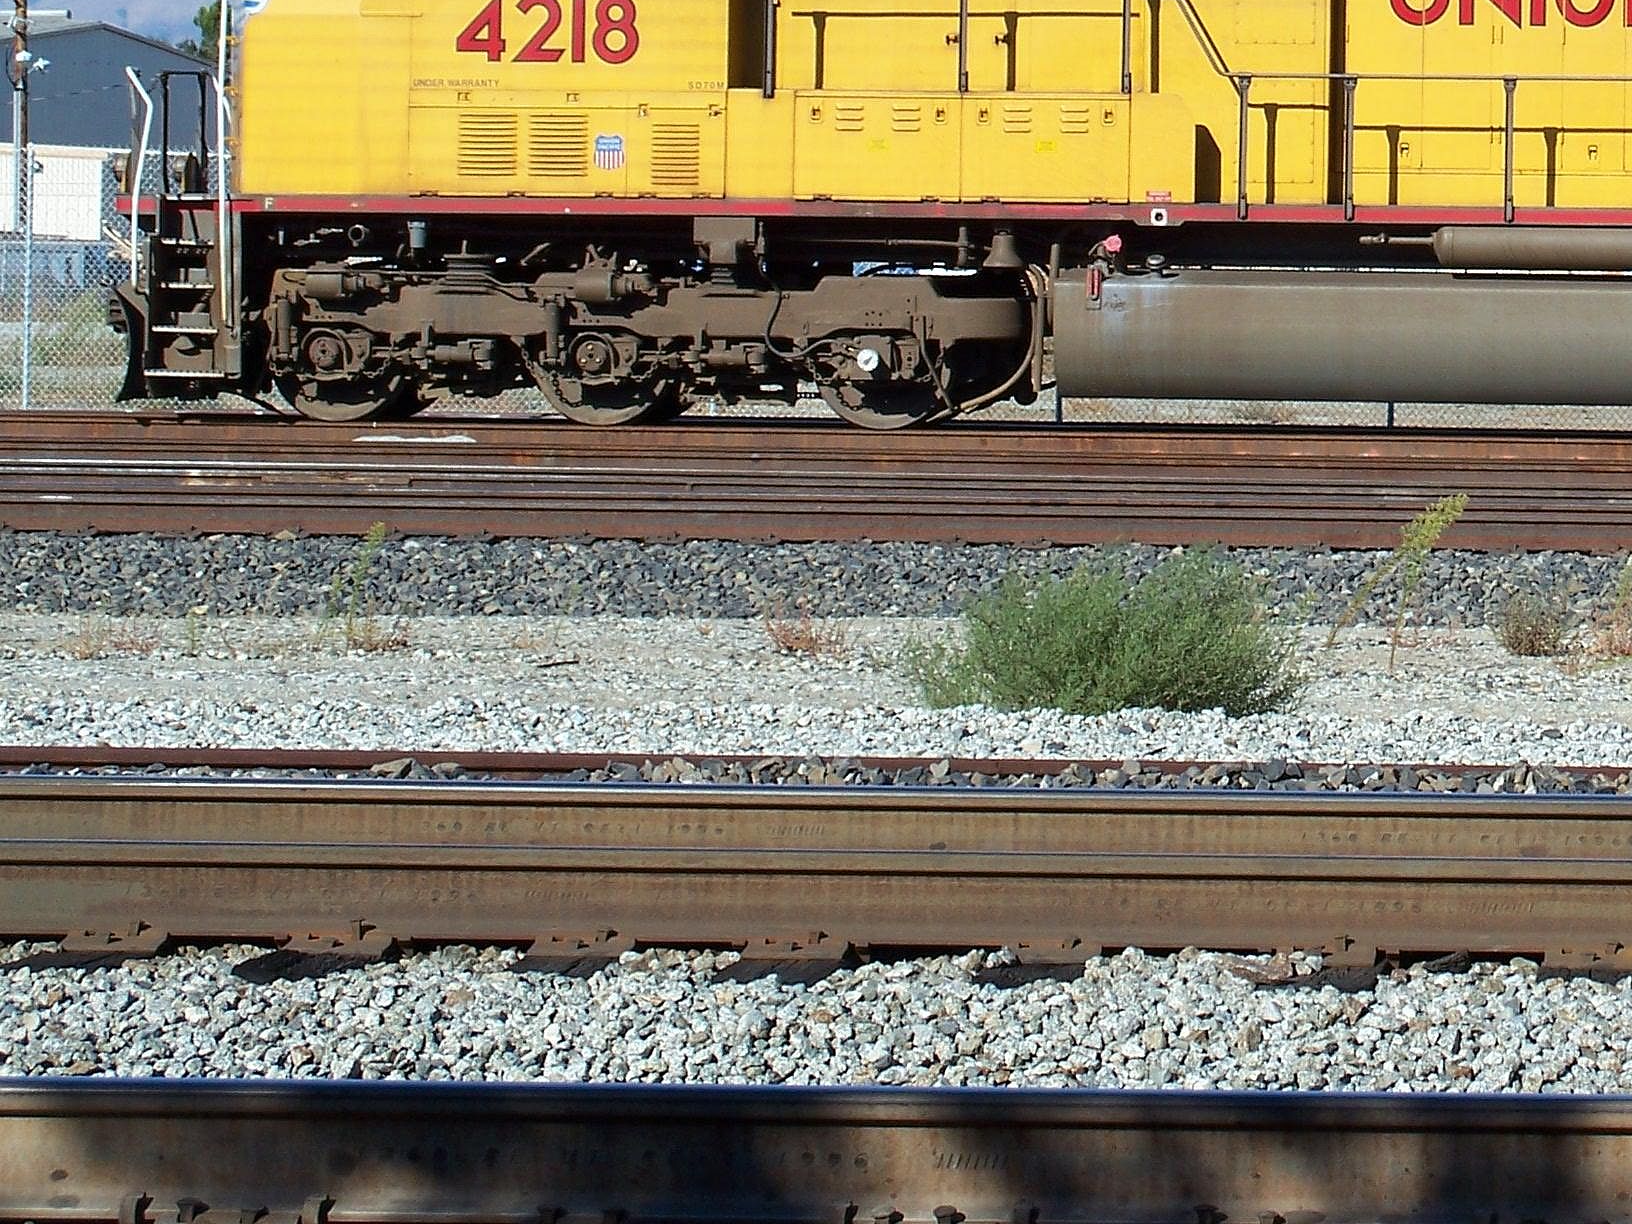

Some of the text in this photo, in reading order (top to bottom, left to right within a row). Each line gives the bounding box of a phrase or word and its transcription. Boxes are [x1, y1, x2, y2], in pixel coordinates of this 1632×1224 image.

[413, 79, 499, 87] UNDER WARRANTY
[688, 81, 725, 90] SD70M
[264, 197, 274, 209] F
